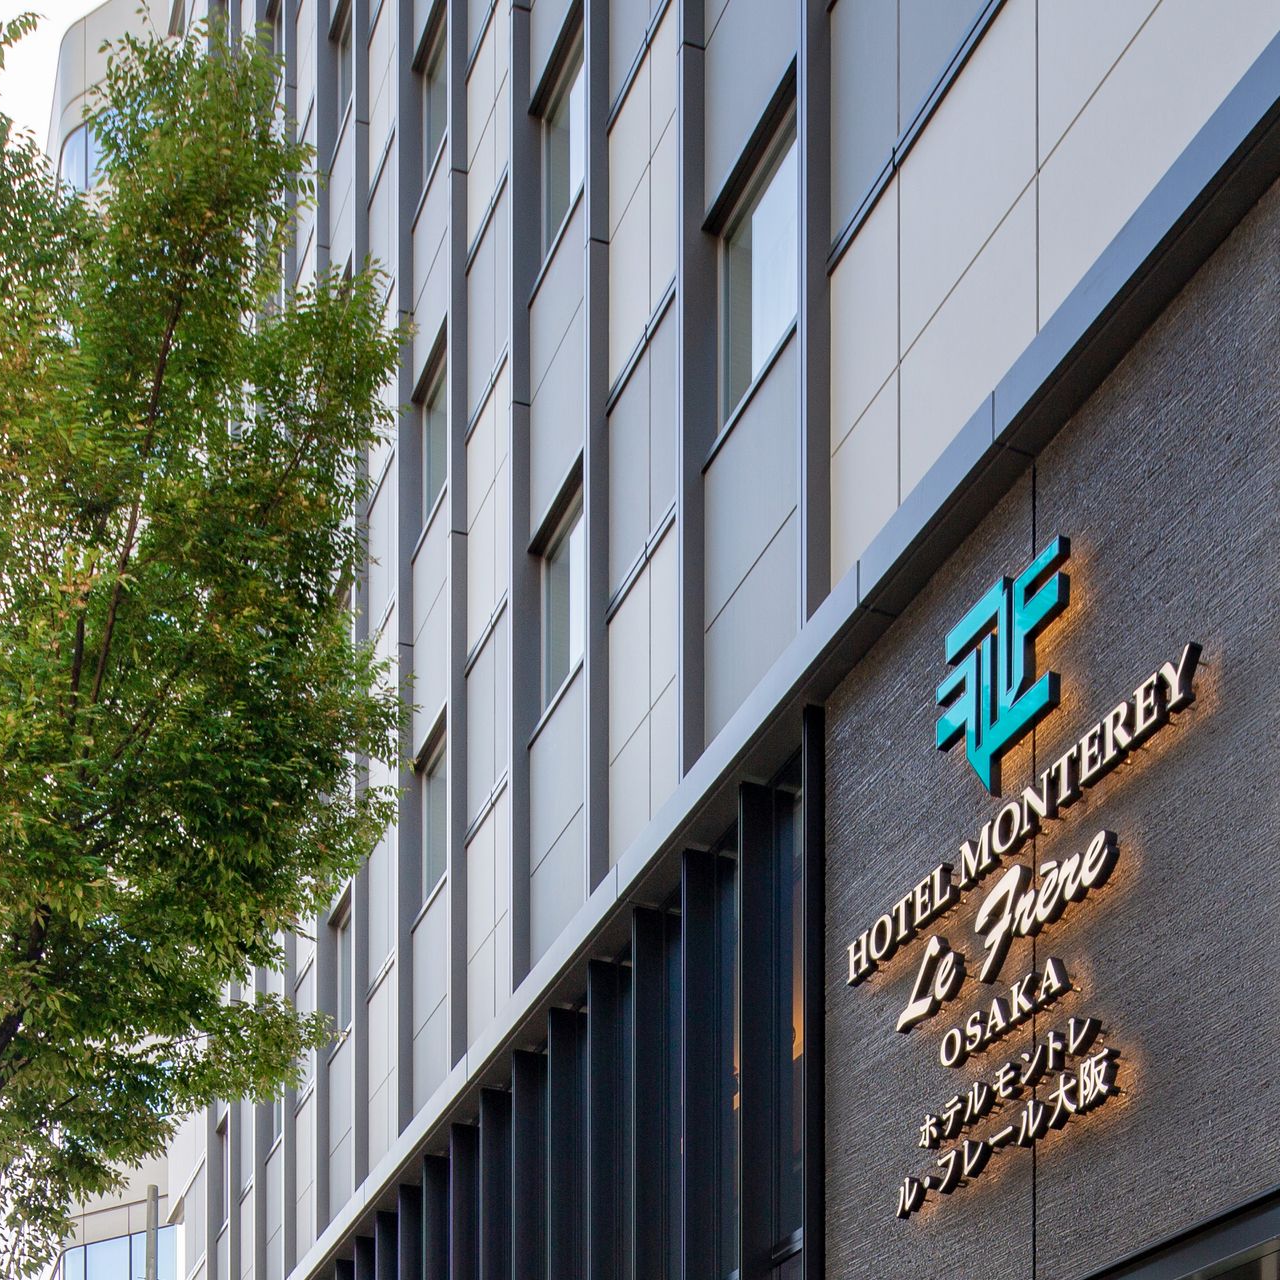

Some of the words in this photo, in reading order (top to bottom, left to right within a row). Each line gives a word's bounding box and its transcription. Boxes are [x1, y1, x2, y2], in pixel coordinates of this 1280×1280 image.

[847, 862, 954, 986] HOTEL
[959, 641, 1202, 890] MONTEREY
[896, 935, 965, 1033] Le
[939, 957, 1070, 1068] OSAKA
[919, 1017, 1101, 1149] ホテルモントレ
